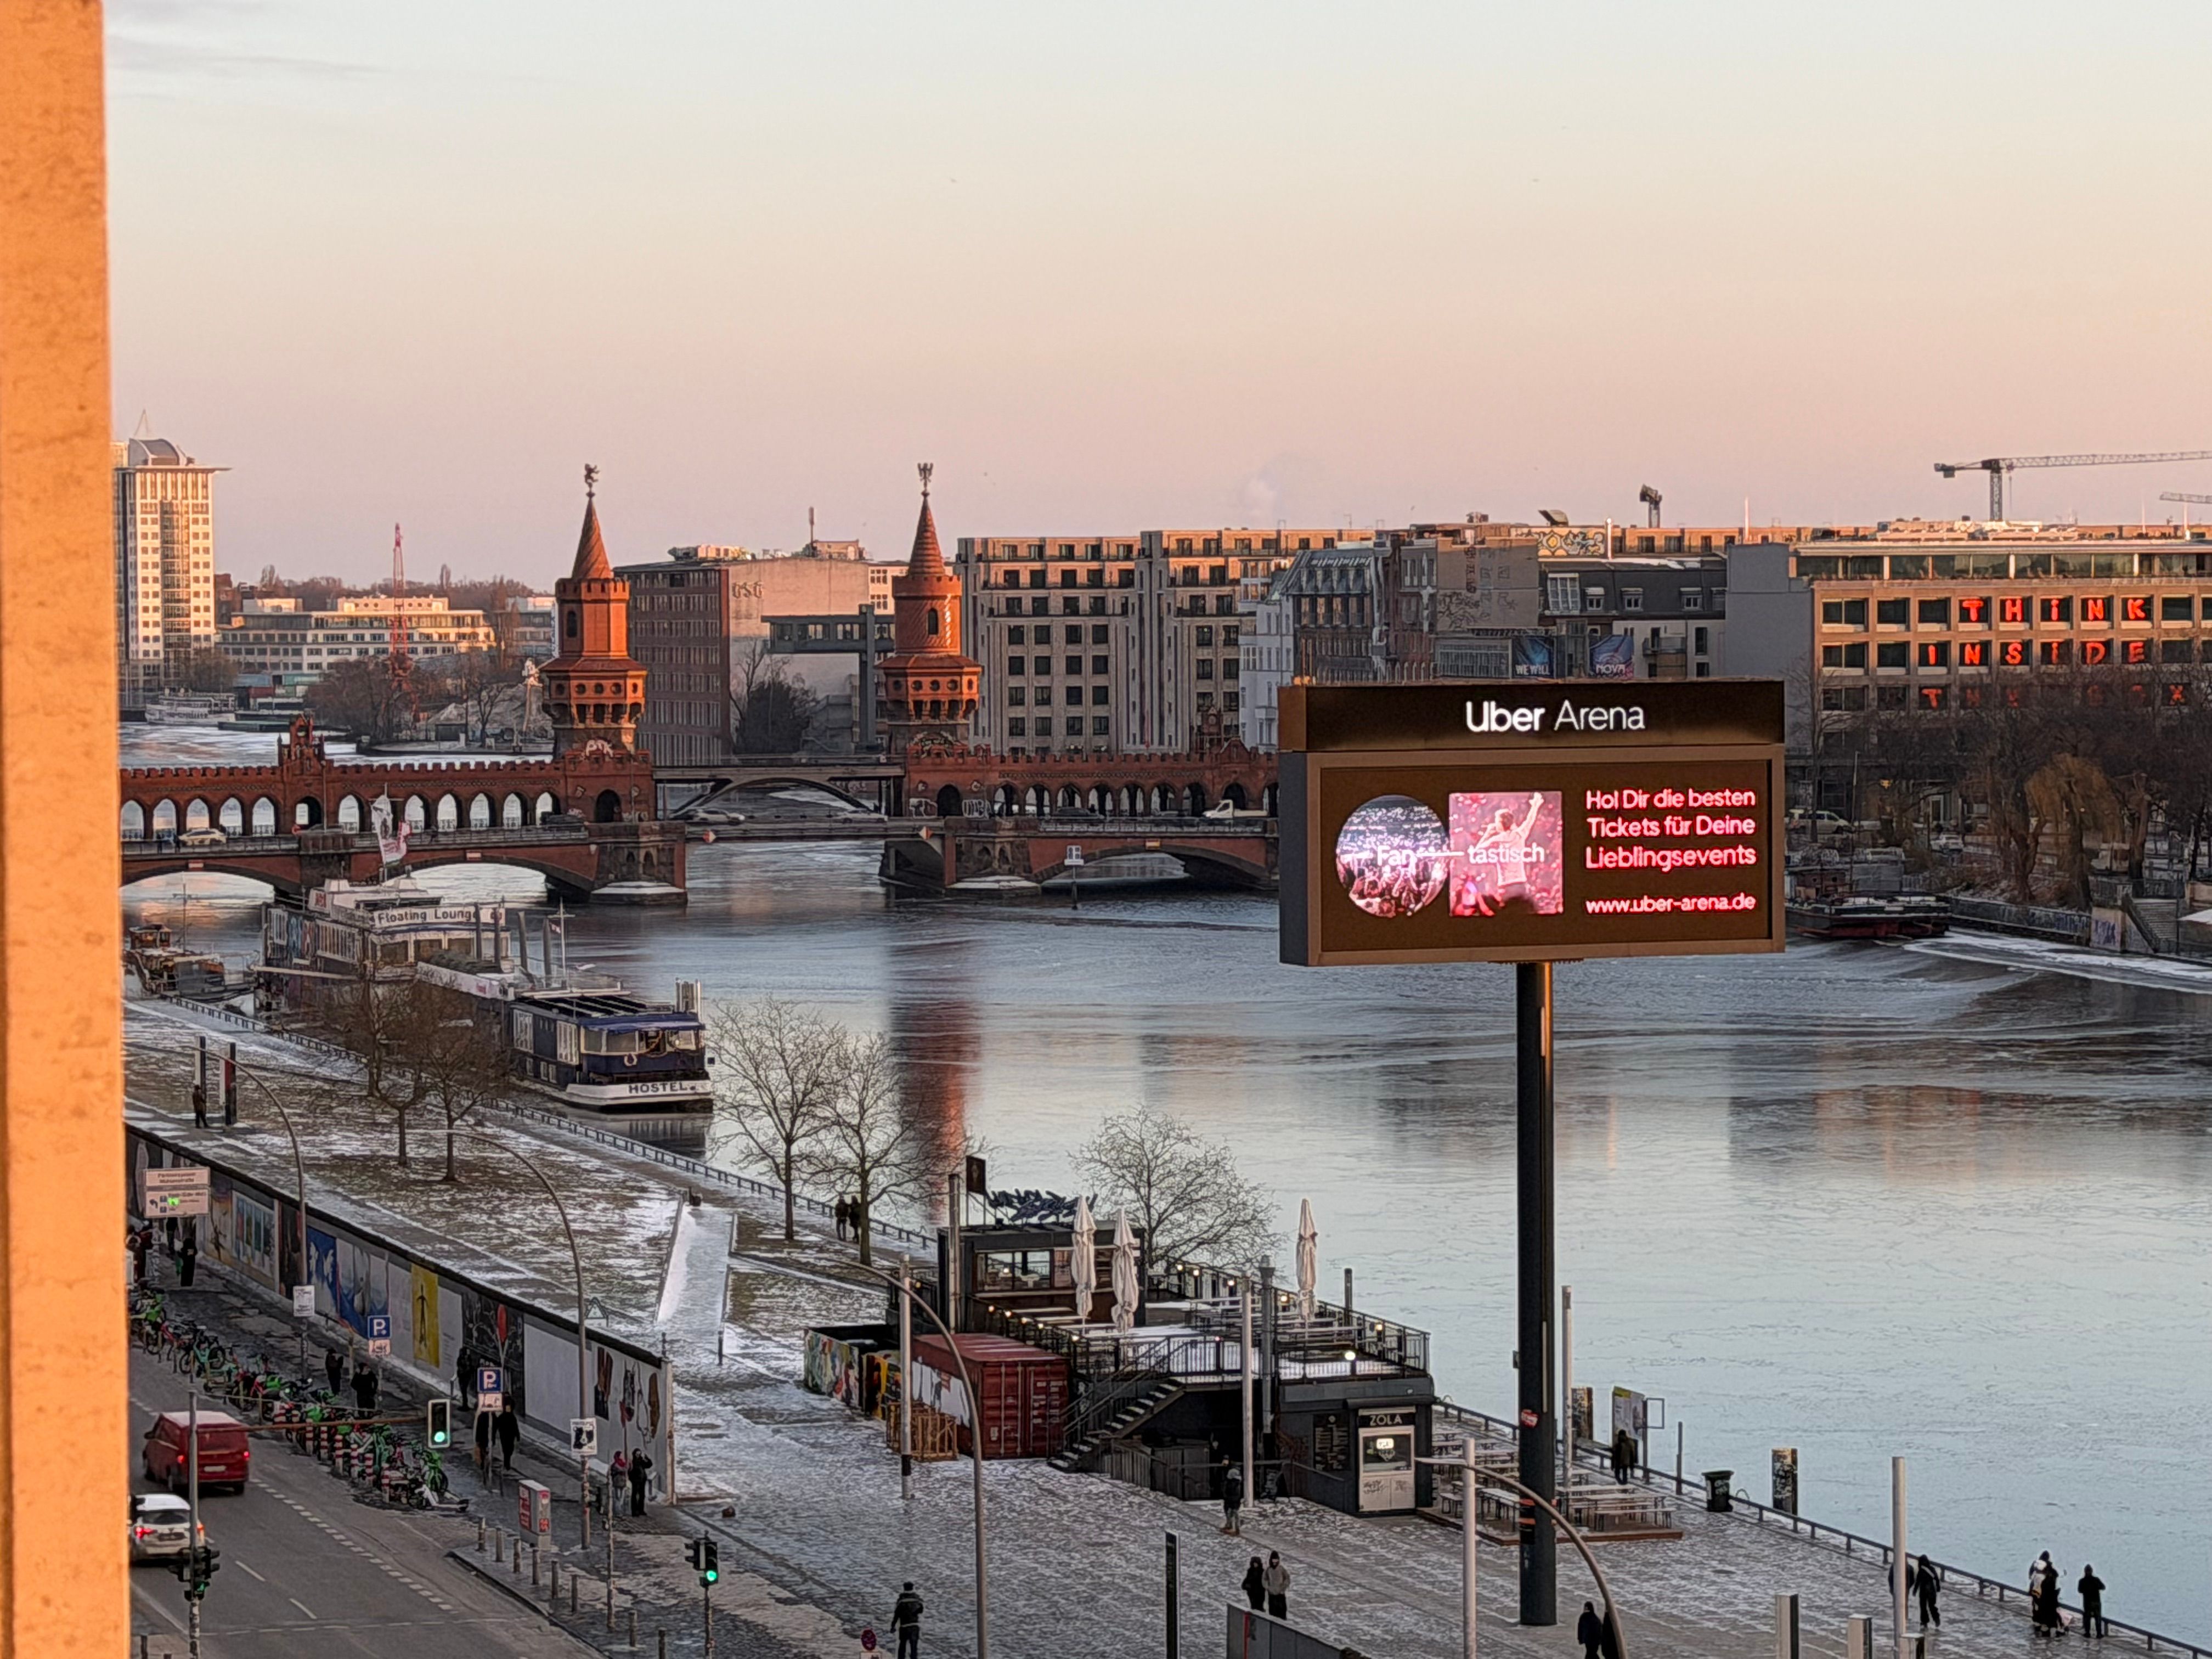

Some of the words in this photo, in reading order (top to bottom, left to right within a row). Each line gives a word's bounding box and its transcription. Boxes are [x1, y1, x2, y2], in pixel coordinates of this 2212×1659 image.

[1466, 701, 1546, 732] Uber
[1554, 699, 1645, 731] Arena
[1586, 789, 1619, 810] Hol
[1622, 789, 1650, 809] Dir
[1653, 788, 1685, 808] die
[1688, 788, 1756, 808] besten
[1587, 816, 1661, 838] Tickets
[1663, 815, 1692, 836] für
[1695, 815, 1756, 836] Deine
[1468, 844, 1545, 865] tastisch
[1586, 844, 1757, 873] Lieblingsevents
[1585, 892, 1756, 913] www.uber-arena.de
[377, 910, 427, 924] Floating
[629, 1081, 687, 1094] HOSTEL
[1369, 1414, 1403, 1426] ZOLA
